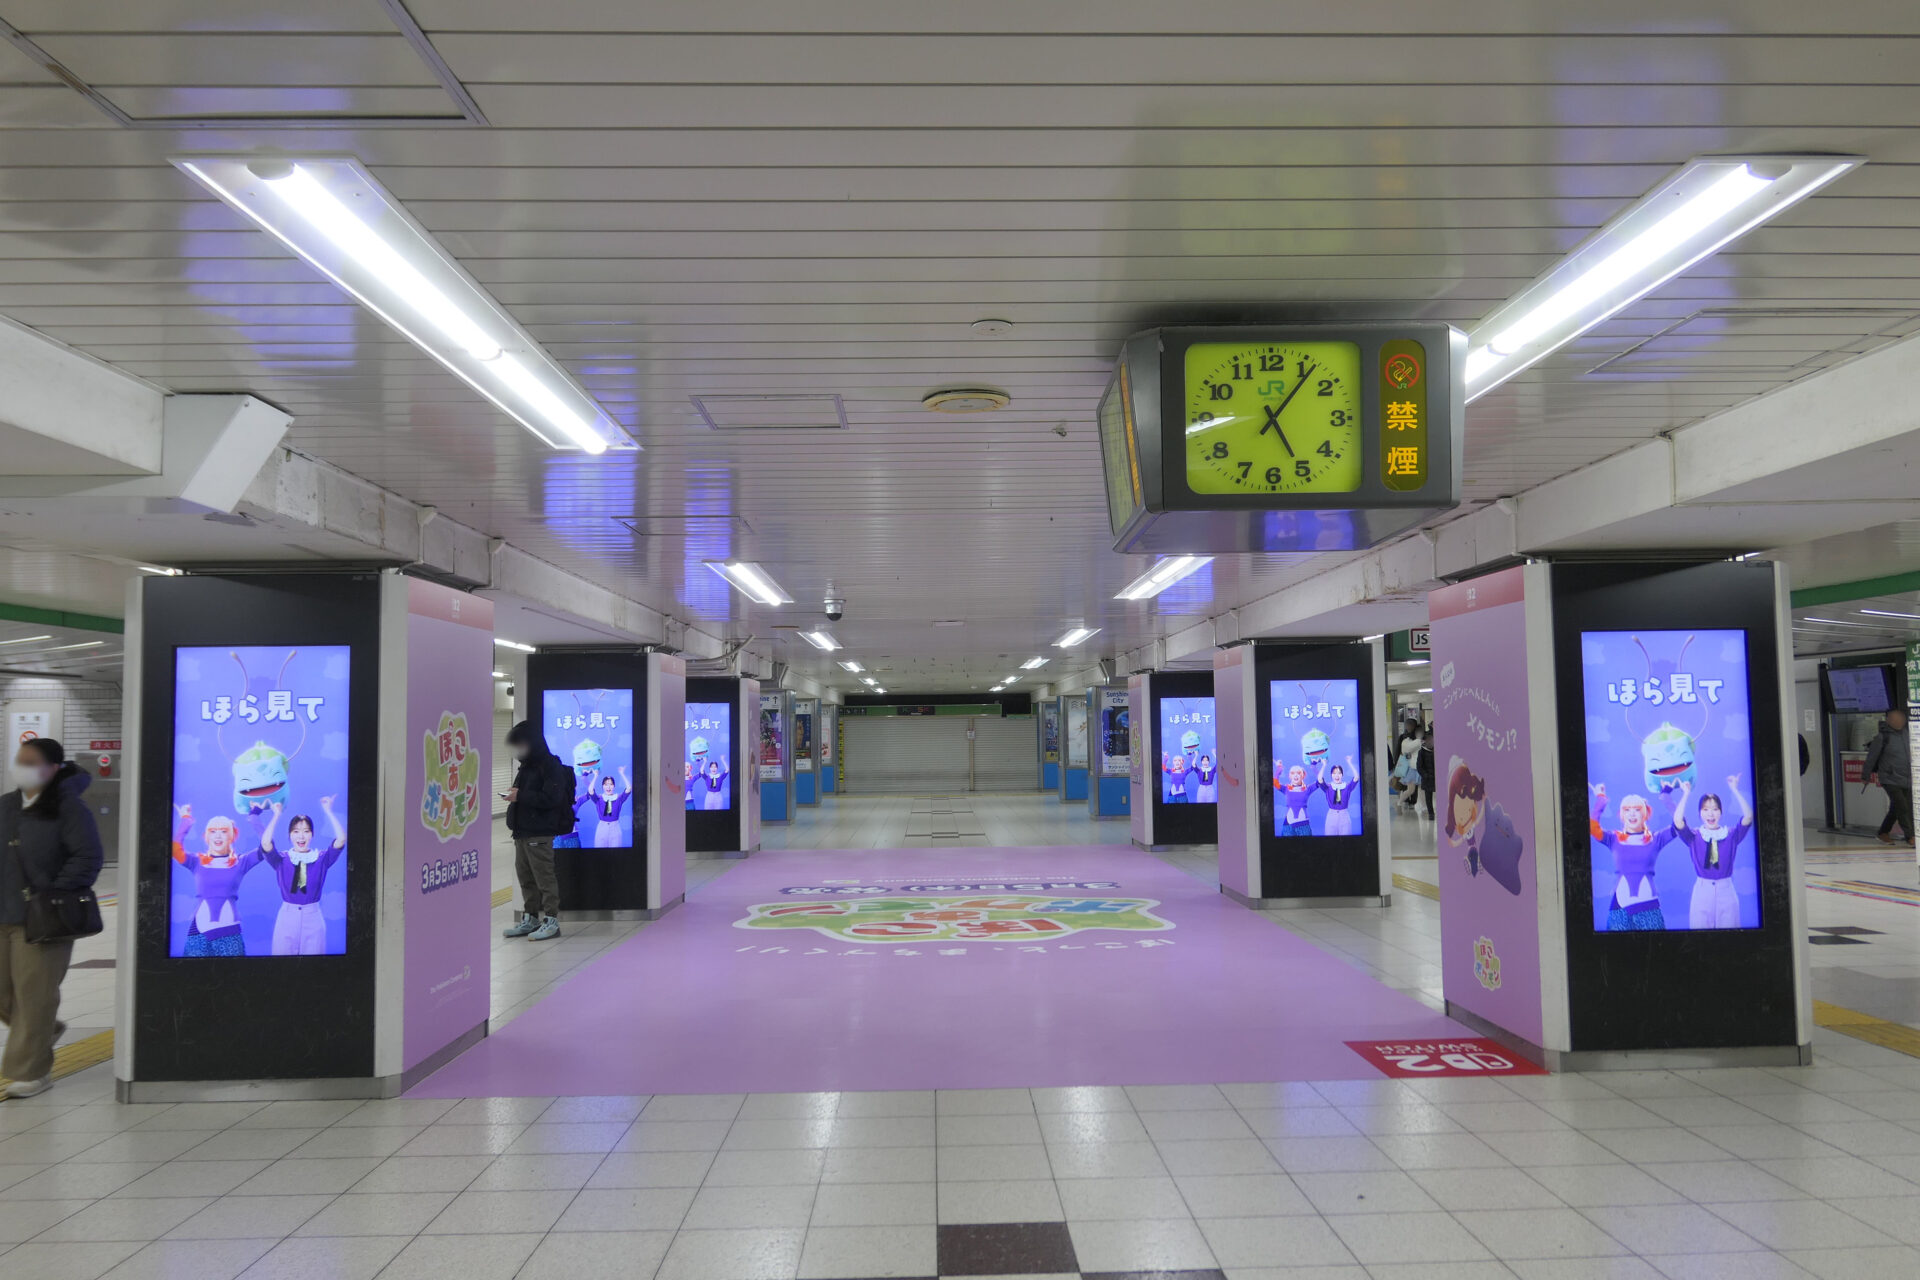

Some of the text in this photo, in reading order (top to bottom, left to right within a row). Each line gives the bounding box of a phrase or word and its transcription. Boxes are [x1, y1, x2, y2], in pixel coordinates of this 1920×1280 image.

[1259, 355, 1284, 371] 12
[1232, 364, 1253, 380] 11
[1209, 384, 1233, 401] 10
[1258, 380, 1284, 396] JR
[1317, 380, 1333, 397] 2
[1330, 410, 1346, 427] 3
[1387, 401, 1419, 476] 禁煙
[1212, 442, 1228, 459] 8
[1316, 440, 1334, 457] 4
[1237, 461, 1253, 479] 7
[1266, 467, 1281, 484] 6
[1294, 460, 1311, 477] 5
[1415, 634, 1428, 645] JS
[1607, 673, 1724, 706] ほら見て
[201, 691, 325, 724] ほら見て
[1284, 702, 1345, 720] ほら見て
[556, 712, 620, 730] ほら見て
[1169, 712, 1212, 725] ほら見て
[424, 783, 477, 827] ポケモン
[1384, 1054, 1446, 1072] 2
